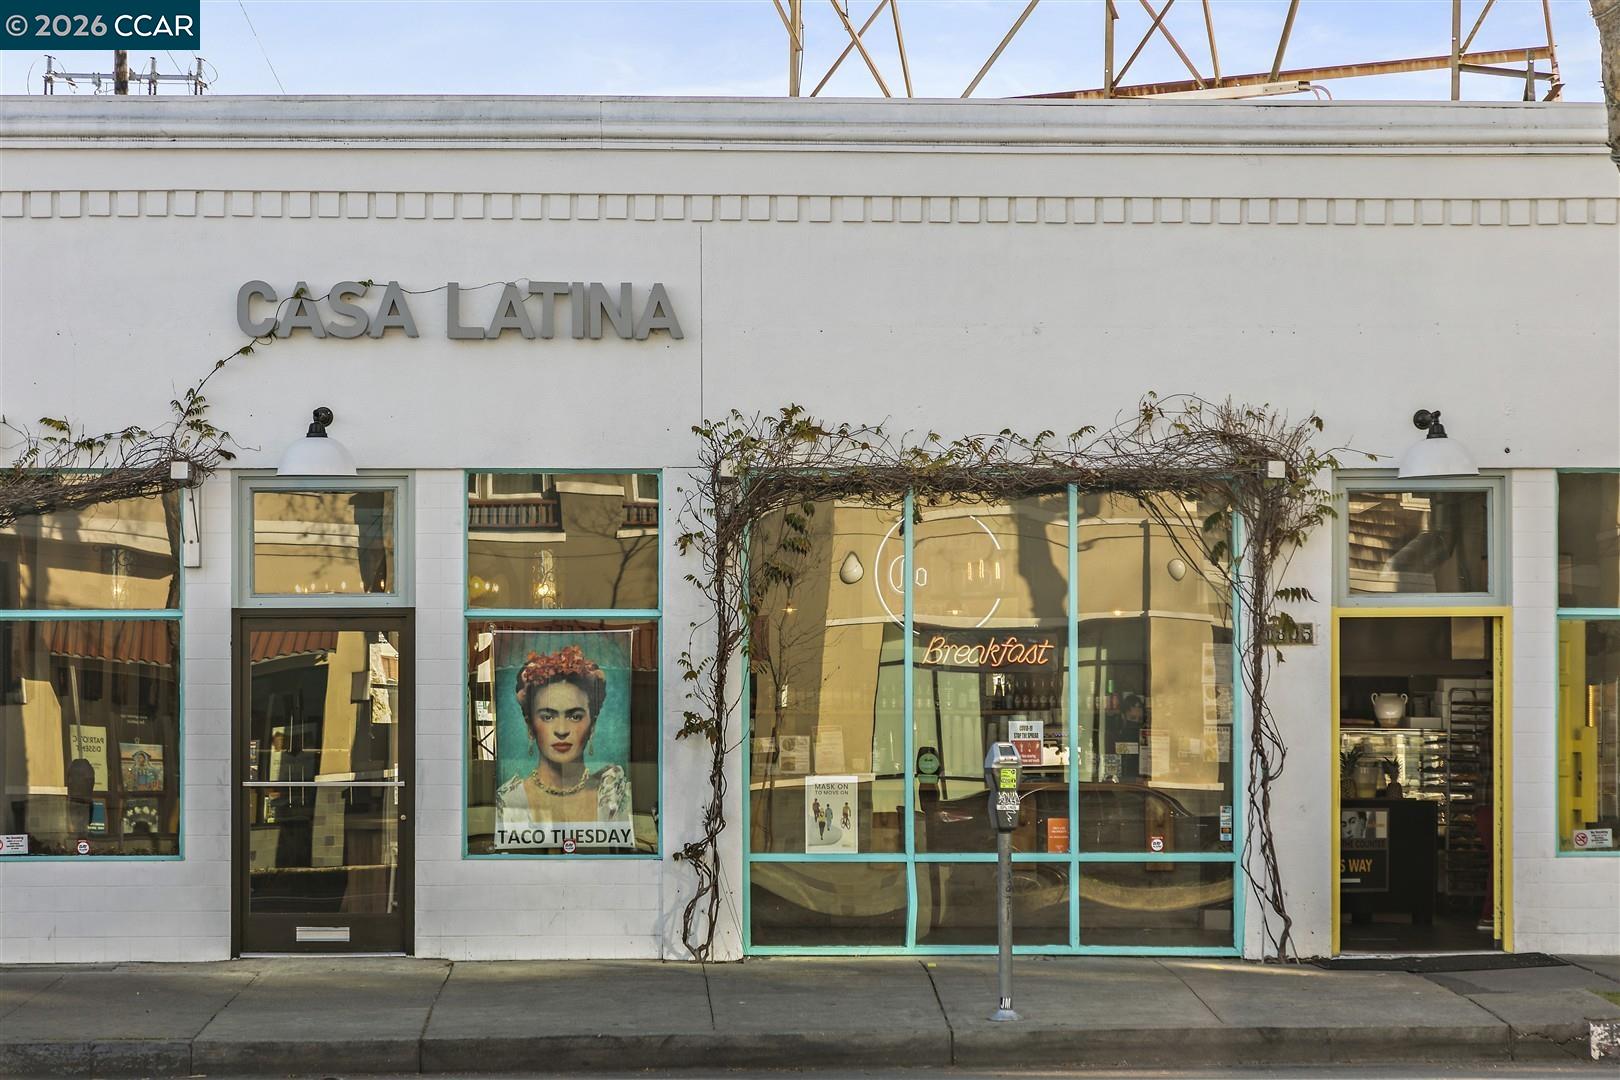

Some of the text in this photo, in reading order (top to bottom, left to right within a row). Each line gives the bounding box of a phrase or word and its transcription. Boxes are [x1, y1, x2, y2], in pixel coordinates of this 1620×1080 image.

[236, 280, 685, 341] CASA LATINA
[922, 635, 1055, 667] Breakfast
[497, 828, 631, 845] TACO TUESDAY
[1348, 859, 1373, 873] WAY
